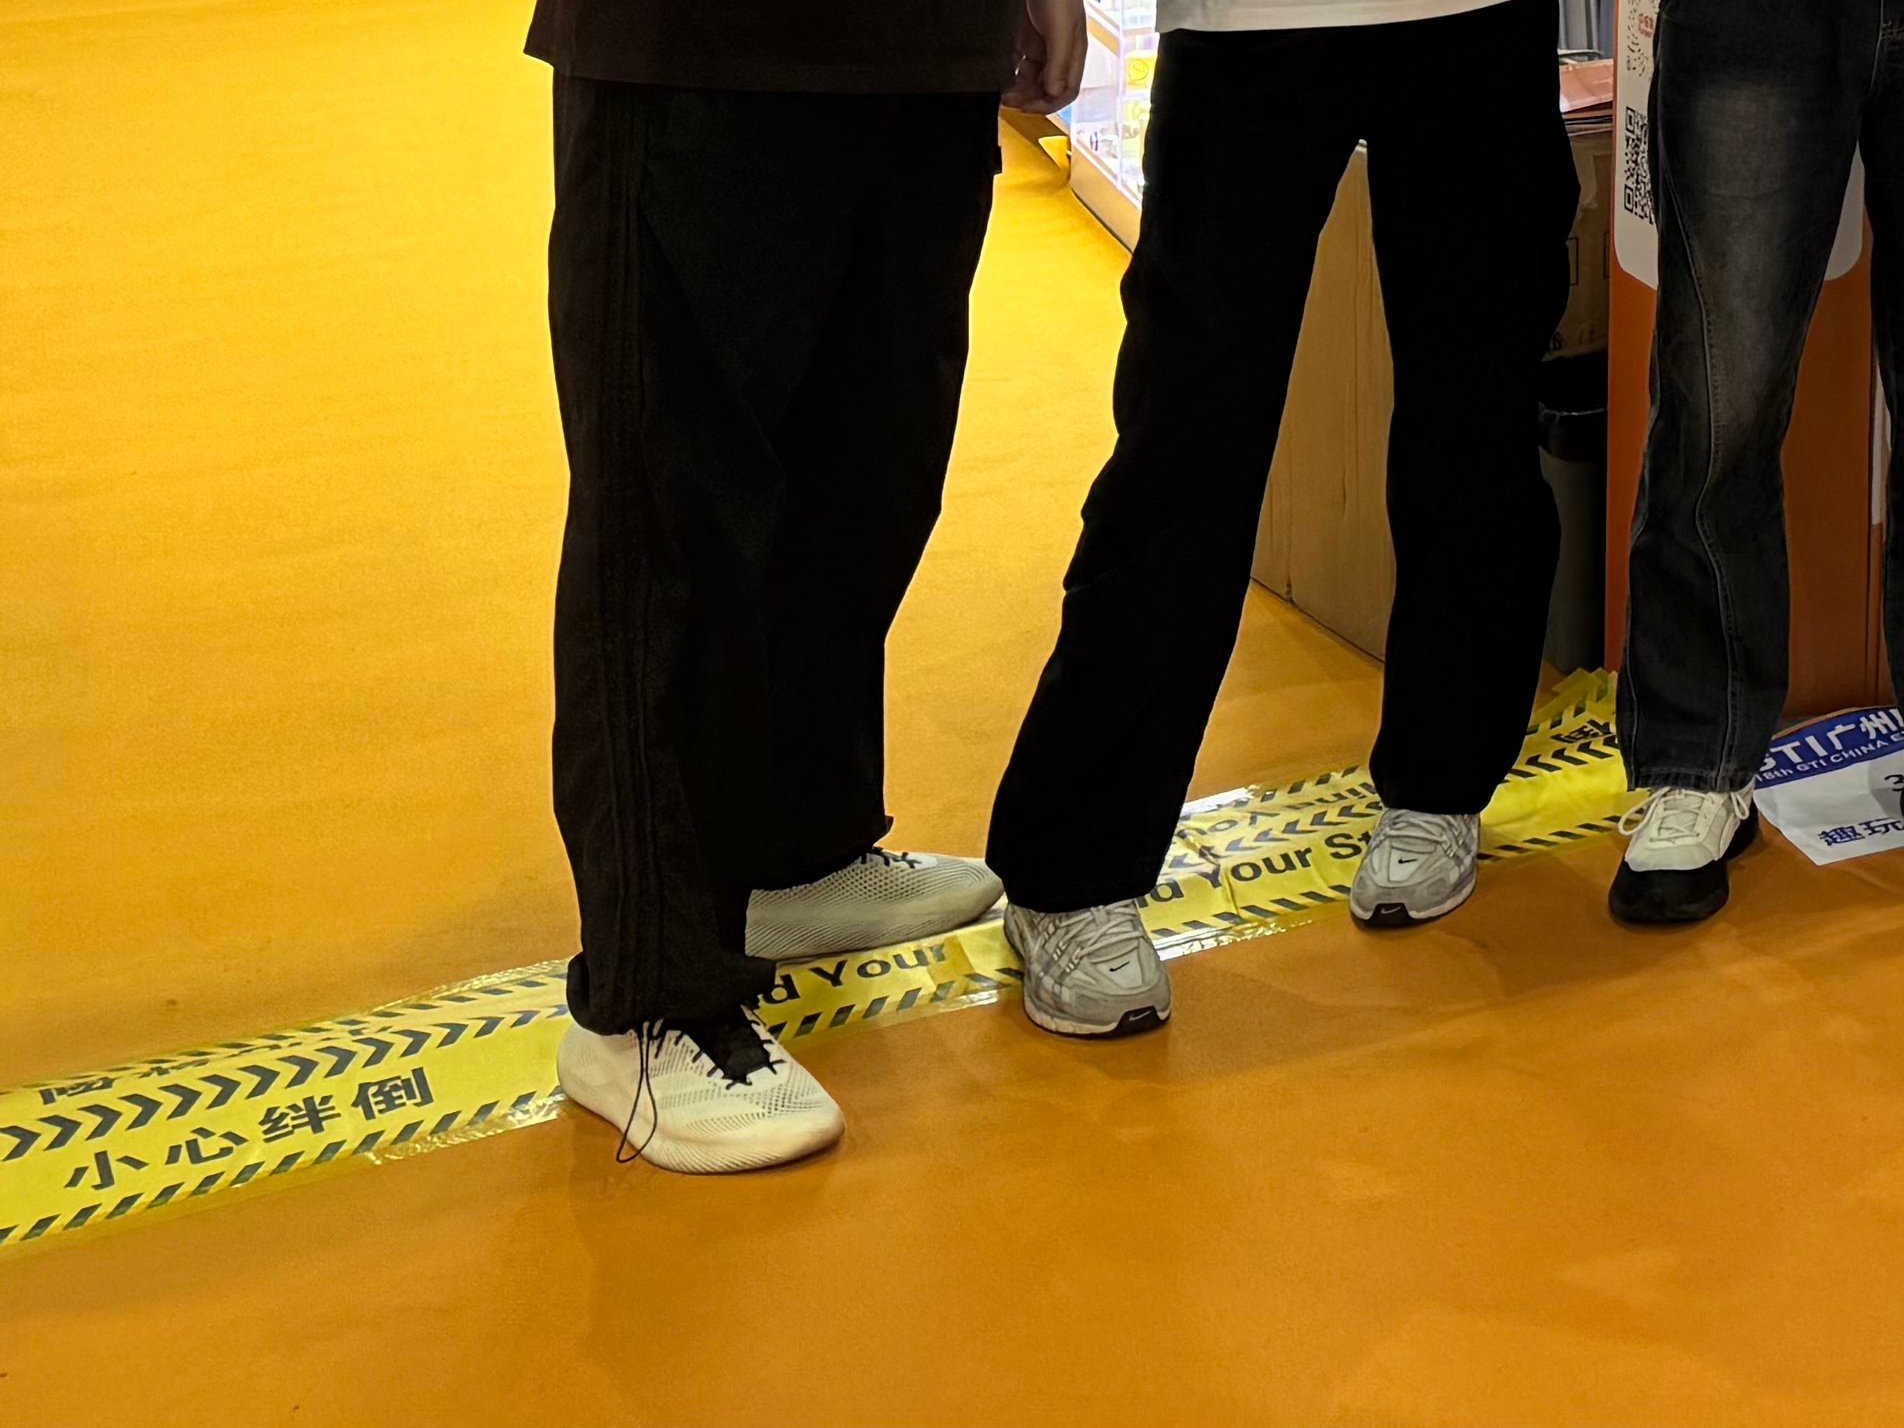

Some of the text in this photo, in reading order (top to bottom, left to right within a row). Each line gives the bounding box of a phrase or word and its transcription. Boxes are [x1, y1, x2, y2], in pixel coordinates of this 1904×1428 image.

[1799, 756, 1826, 771] GTI
[1829, 740, 1885, 763] CHINA
[1207, 847, 1322, 890] Your
[797, 939, 948, 990] Your
[64, 1065, 435, 1196] 小心绊倒
